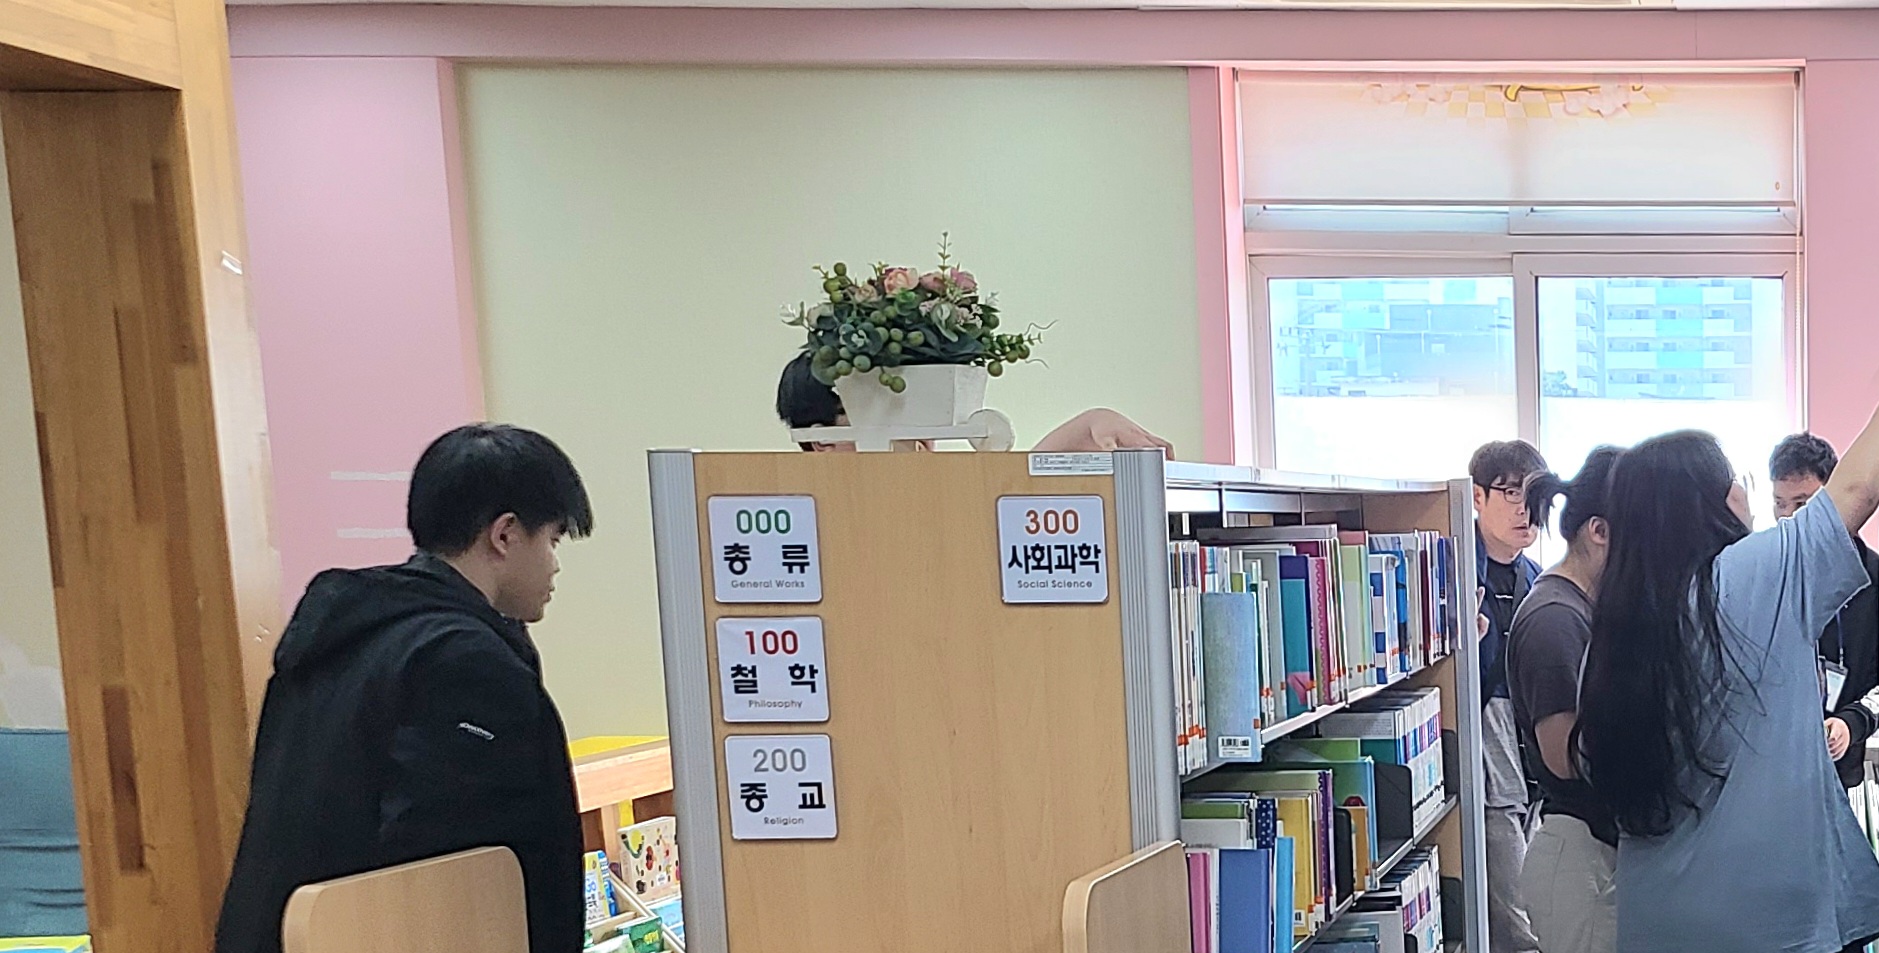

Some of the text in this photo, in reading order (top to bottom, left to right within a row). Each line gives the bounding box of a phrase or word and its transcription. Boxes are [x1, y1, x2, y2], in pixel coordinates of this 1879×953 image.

[737, 510, 790, 534] 000
[1025, 510, 1078, 534] 300
[724, 543, 810, 575] 총 류
[1008, 543, 1101, 574] 사회과학
[731, 579, 806, 589] General Works
[1017, 579, 1093, 589] Social Science
[745, 630, 798, 654] 100
[731, 664, 818, 694] 철 학
[748, 699, 803, 710] Philosophy
[753, 749, 806, 772] 200
[740, 782, 826, 812] 종 교
[763, 816, 805, 828] Religion
